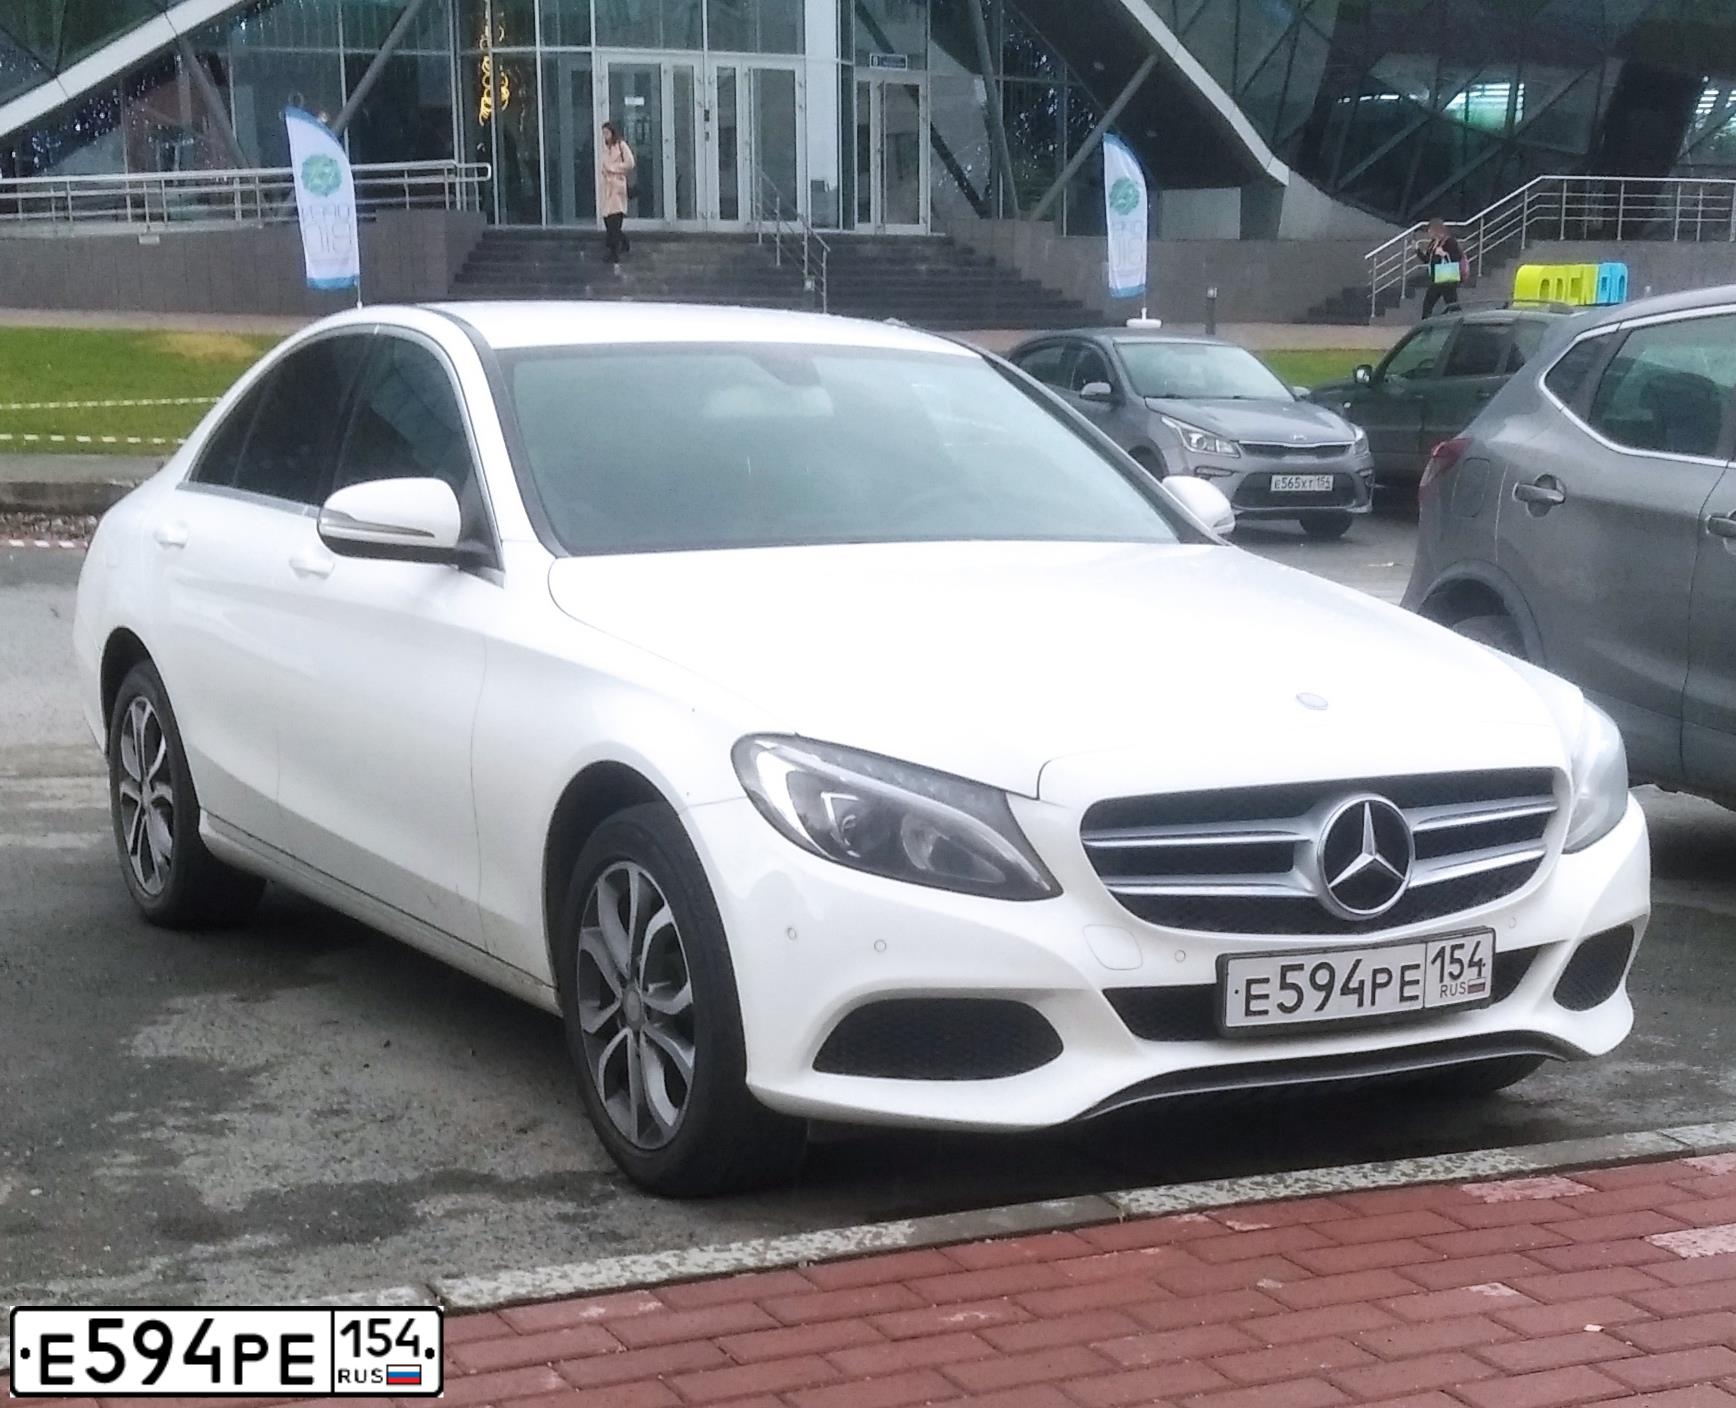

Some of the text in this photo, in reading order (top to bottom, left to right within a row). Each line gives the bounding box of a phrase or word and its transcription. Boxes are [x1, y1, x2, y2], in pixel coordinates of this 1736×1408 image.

[1244, 940, 1483, 1017] Е594РЕ 154
[1440, 981, 1466, 998] RUS
